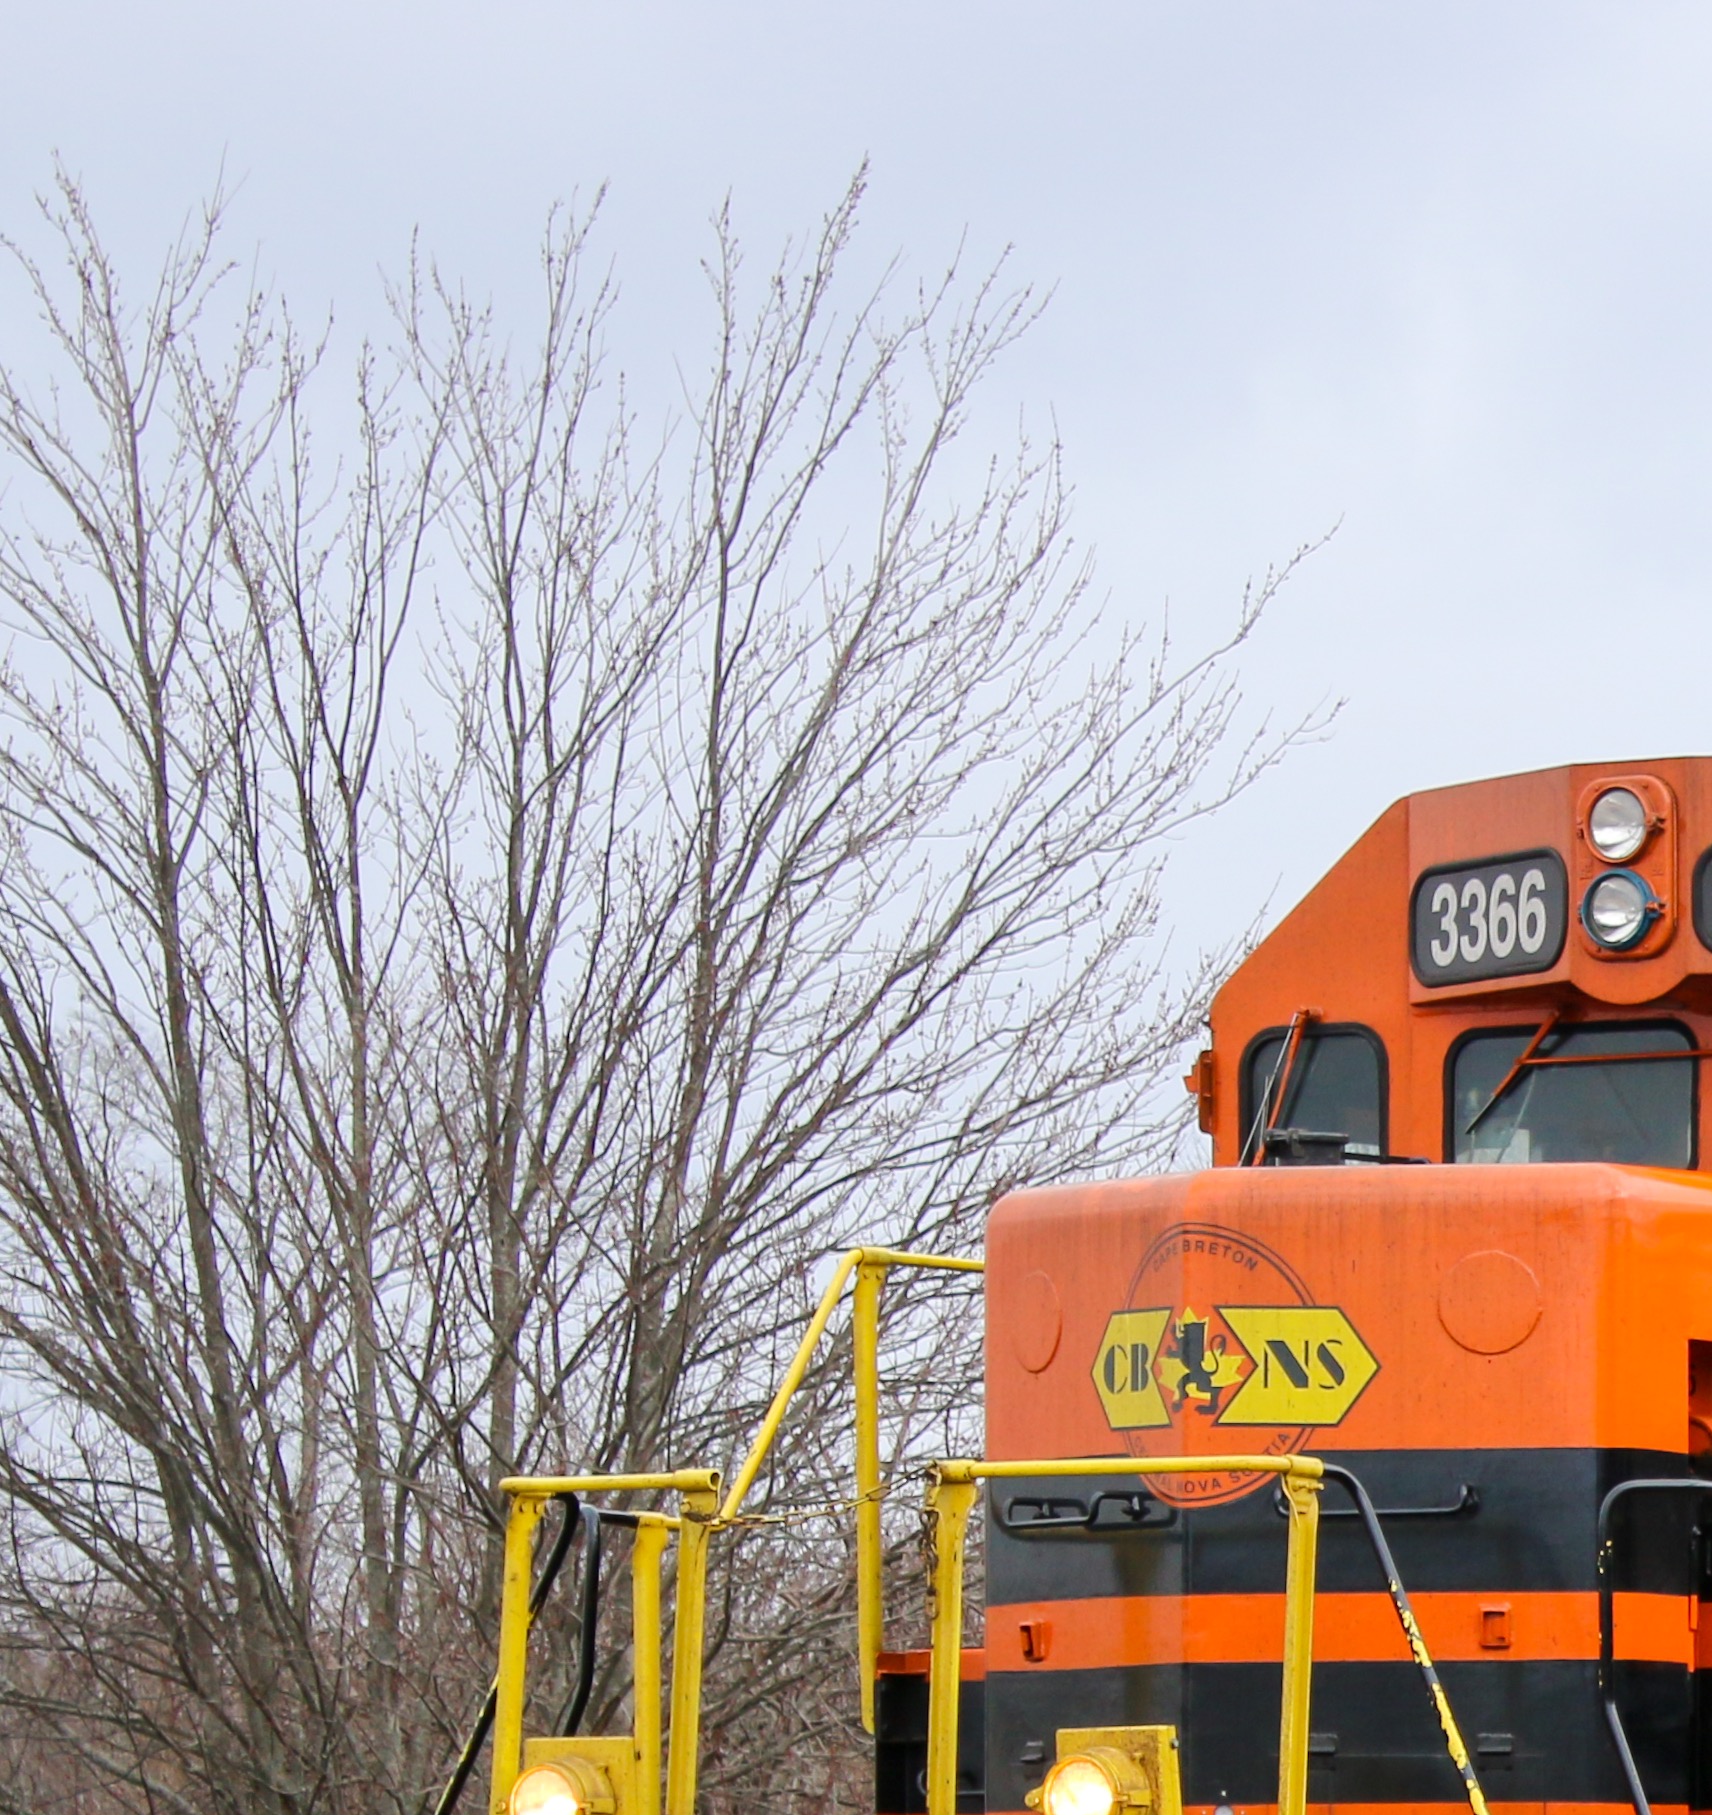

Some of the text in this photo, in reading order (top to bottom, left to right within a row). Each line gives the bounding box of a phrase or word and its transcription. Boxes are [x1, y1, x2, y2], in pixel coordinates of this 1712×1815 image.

[1430, 868, 1547, 967] 3366
[1182, 1238, 1259, 1272] BRETON
[1103, 1338, 1346, 1393] CB NS
